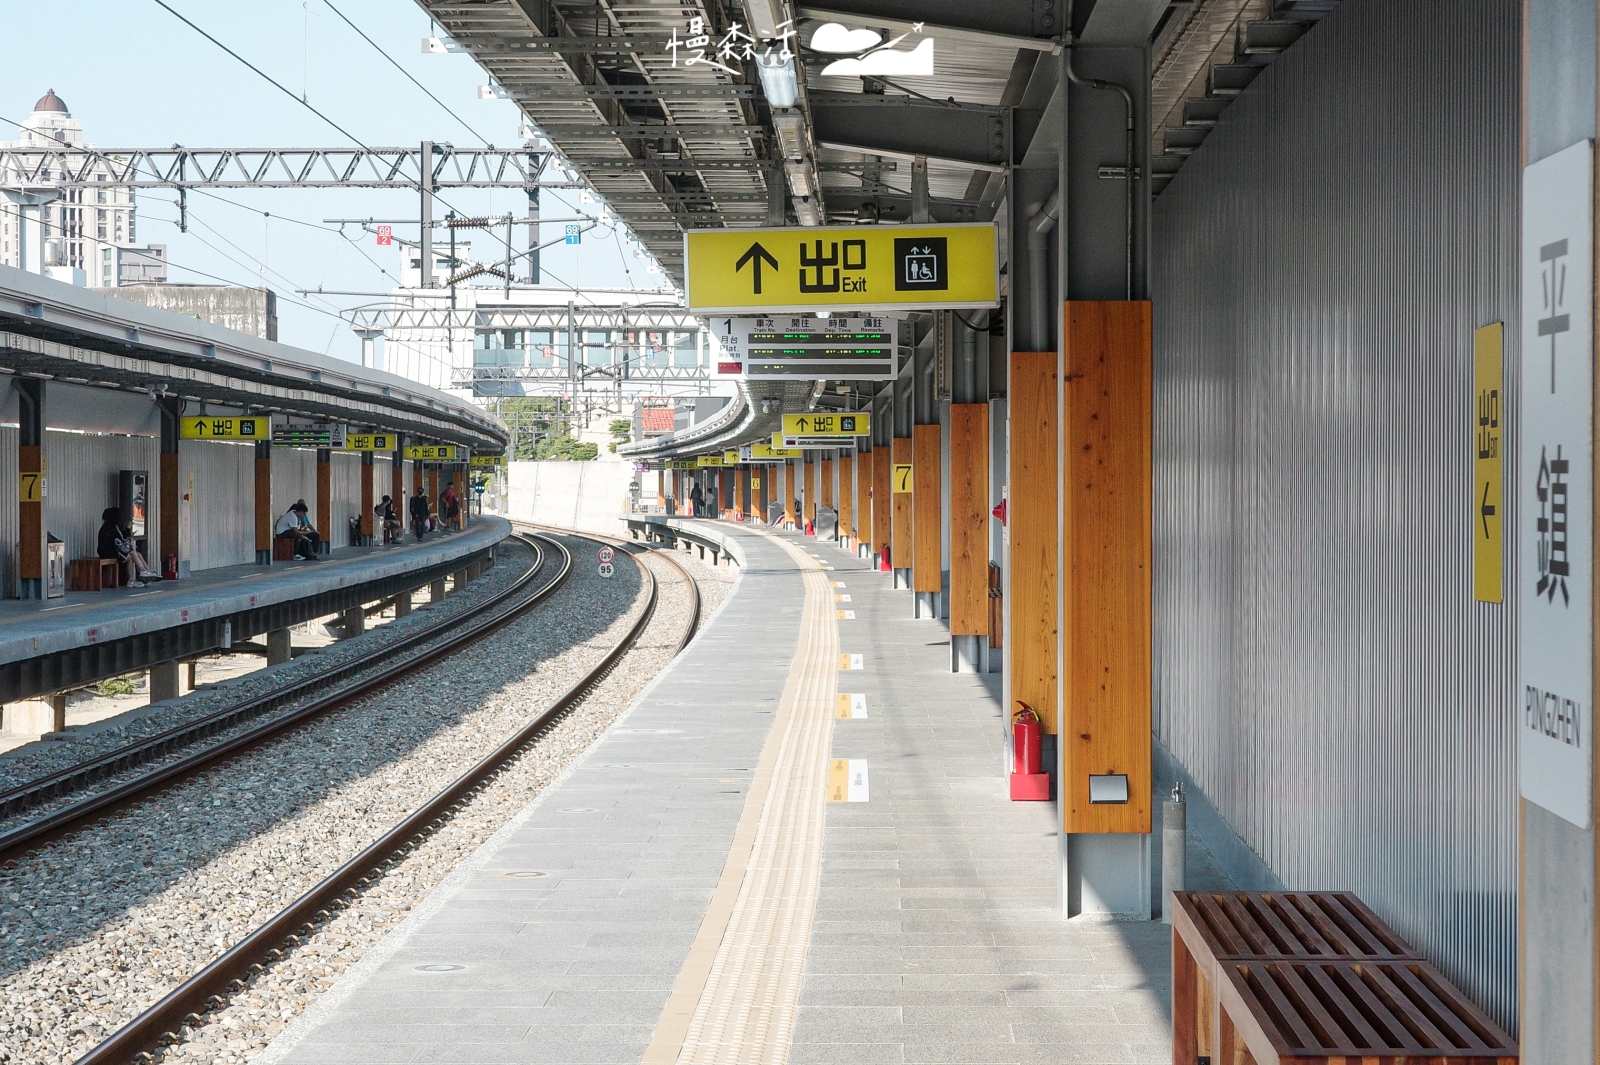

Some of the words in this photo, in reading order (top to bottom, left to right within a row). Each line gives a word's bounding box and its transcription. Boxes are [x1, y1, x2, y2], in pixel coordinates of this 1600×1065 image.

[379, 226, 391, 235] 69
[566, 225, 578, 234] 69
[381, 236, 388, 245] 2
[569, 235, 575, 244] 1
[799, 239, 866, 293] 出口
[842, 276, 867, 293] Exit
[723, 318, 732, 335] 1
[756, 318, 775, 328] 車次
[791, 318, 810, 328] 開往
[828, 318, 848, 328] 時間
[863, 318, 882, 328] 備註
[721, 335, 738, 344] 月台
[719, 344, 739, 352] Plat.
[212, 420, 232, 435] 出口
[814, 417, 833, 432] 出口
[1479, 389, 1498, 459] 出口
[1537, 238, 1570, 609] 平鎮
[354, 436, 368, 448] 出口
[422, 448, 434, 457] 出口
[753, 479, 758, 488] 6
[896, 466, 911, 490] 7
[22, 474, 38, 499] 7
[601, 565, 611, 573] 95
[1526, 684, 1580, 748] PINGZHEN
